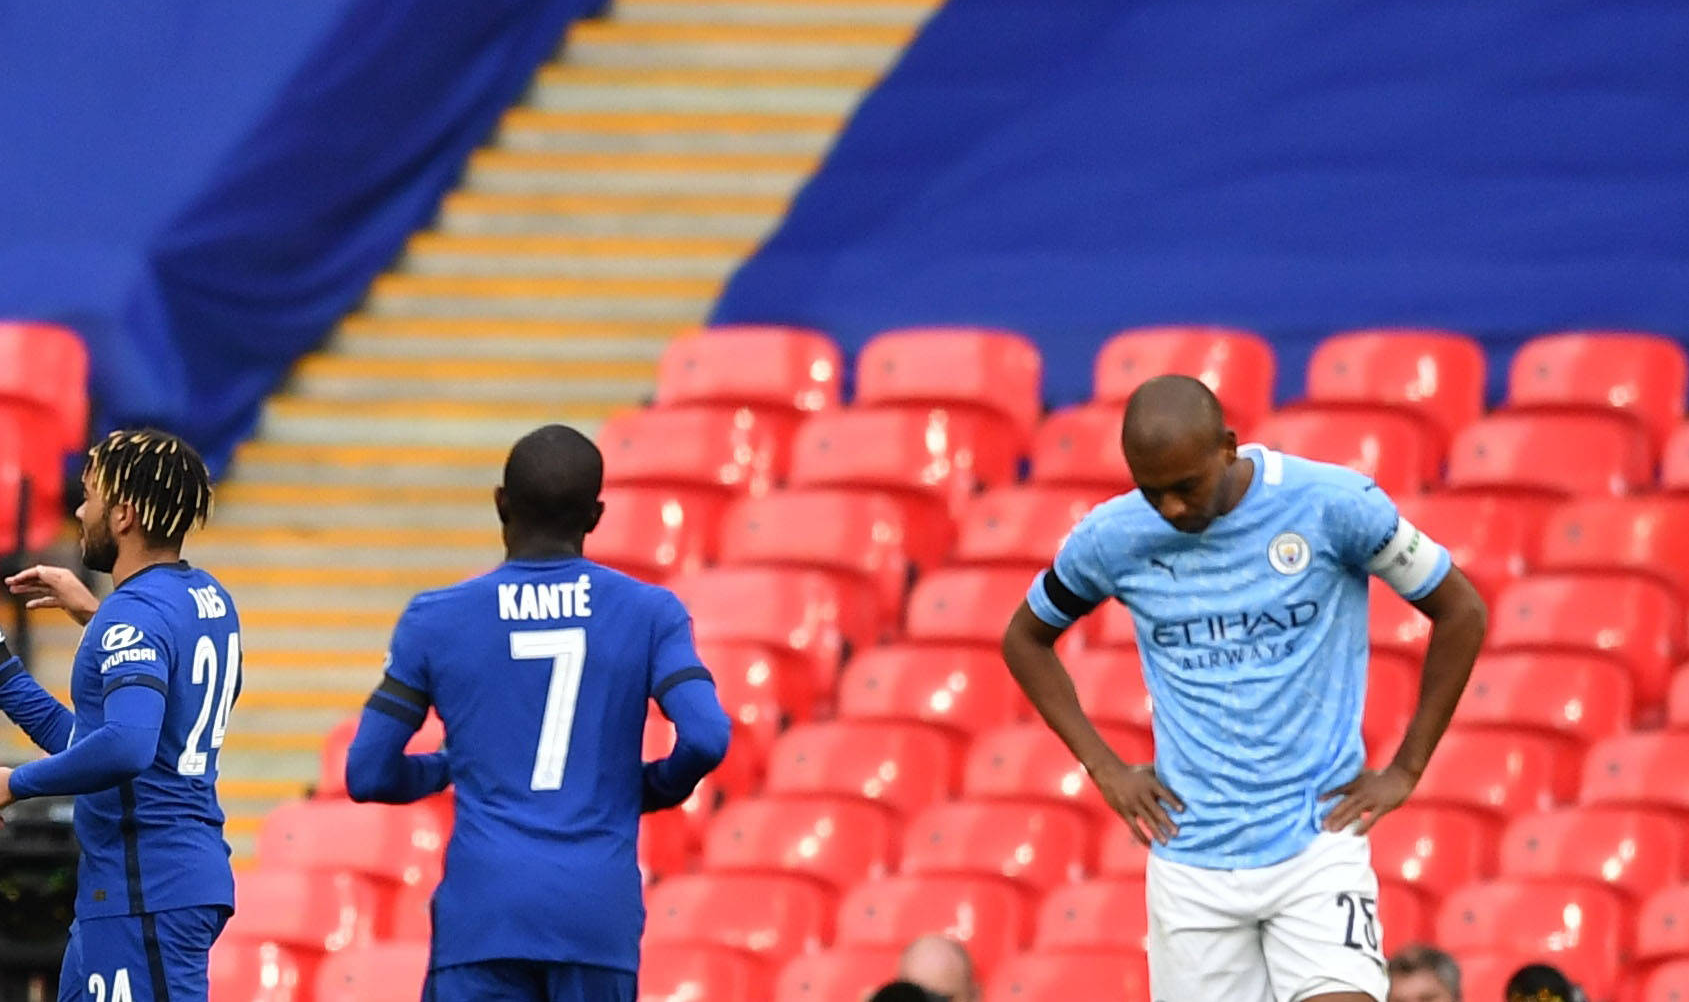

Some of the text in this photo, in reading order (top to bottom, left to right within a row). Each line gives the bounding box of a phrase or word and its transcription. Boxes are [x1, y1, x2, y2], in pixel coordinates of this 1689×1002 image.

[498, 574, 592, 620] KANTÉ
[1152, 601, 1318, 648] ETIHAD
[100, 648, 157, 674] HYUNDAI
[1182, 639, 1296, 671] AIRWAYS
[510, 627, 587, 791] 7
